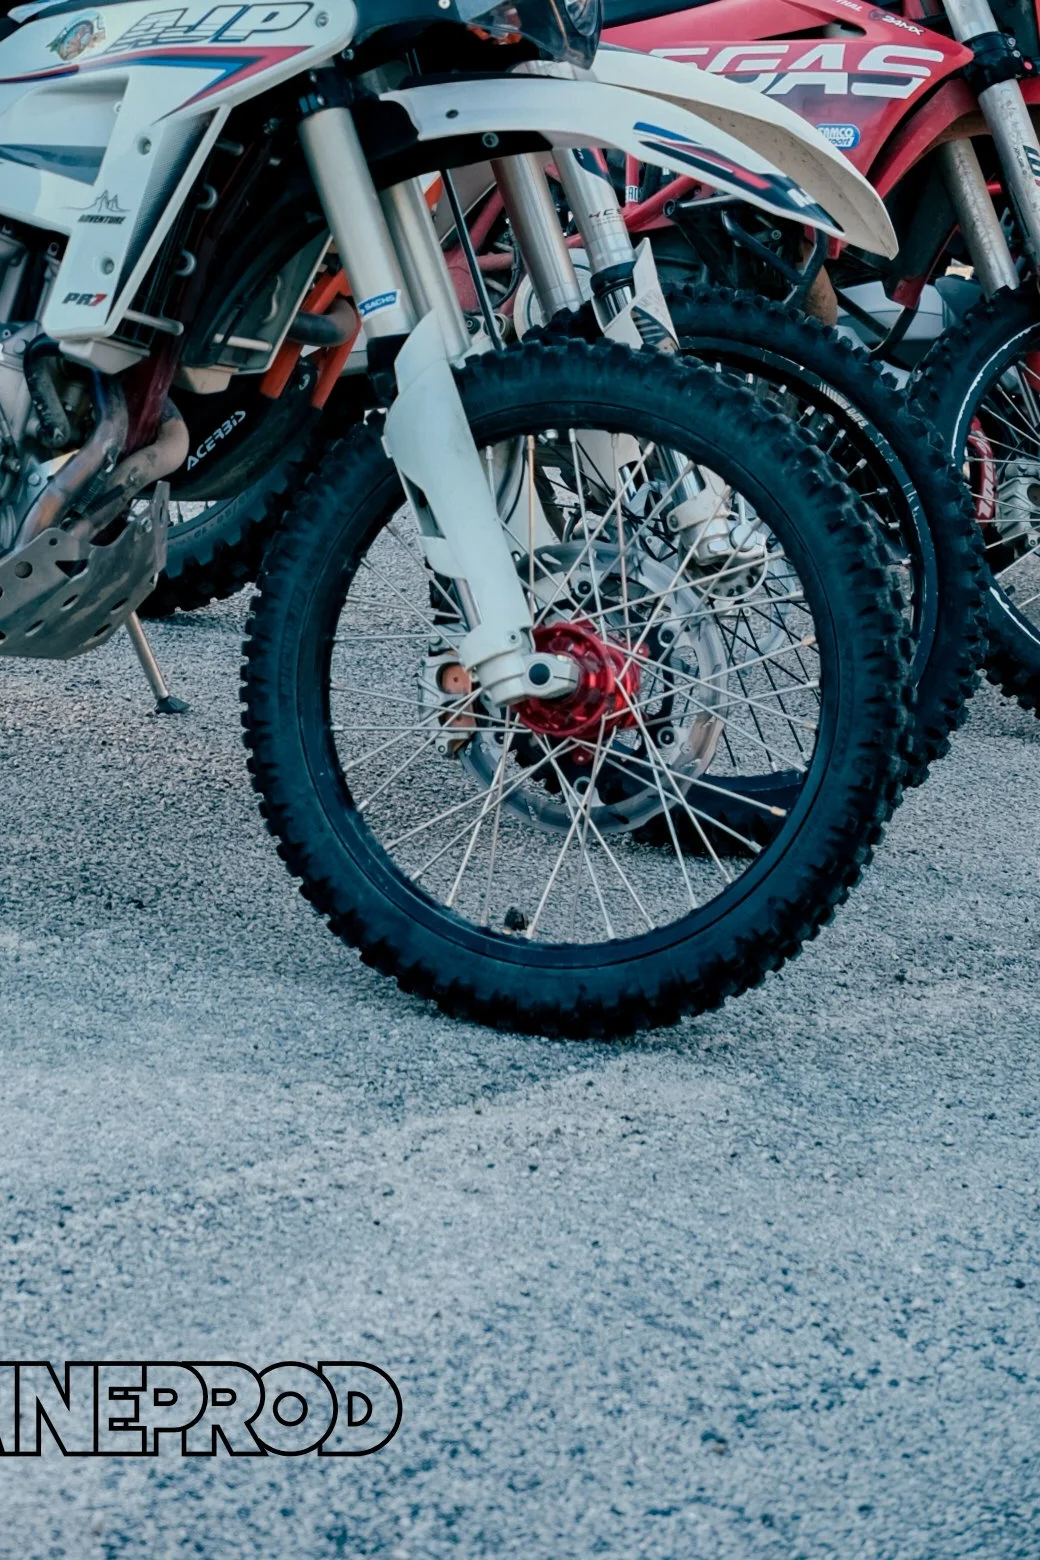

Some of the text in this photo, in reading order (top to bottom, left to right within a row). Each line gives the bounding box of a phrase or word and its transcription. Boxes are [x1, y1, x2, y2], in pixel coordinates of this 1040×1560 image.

[108, 1, 314, 53] AJP
[881, 14, 925, 36] 24MX
[77, 214, 127, 225] ADVENTURE
[62, 292, 108, 307] PR7
[364, 294, 396, 310] SACHS
